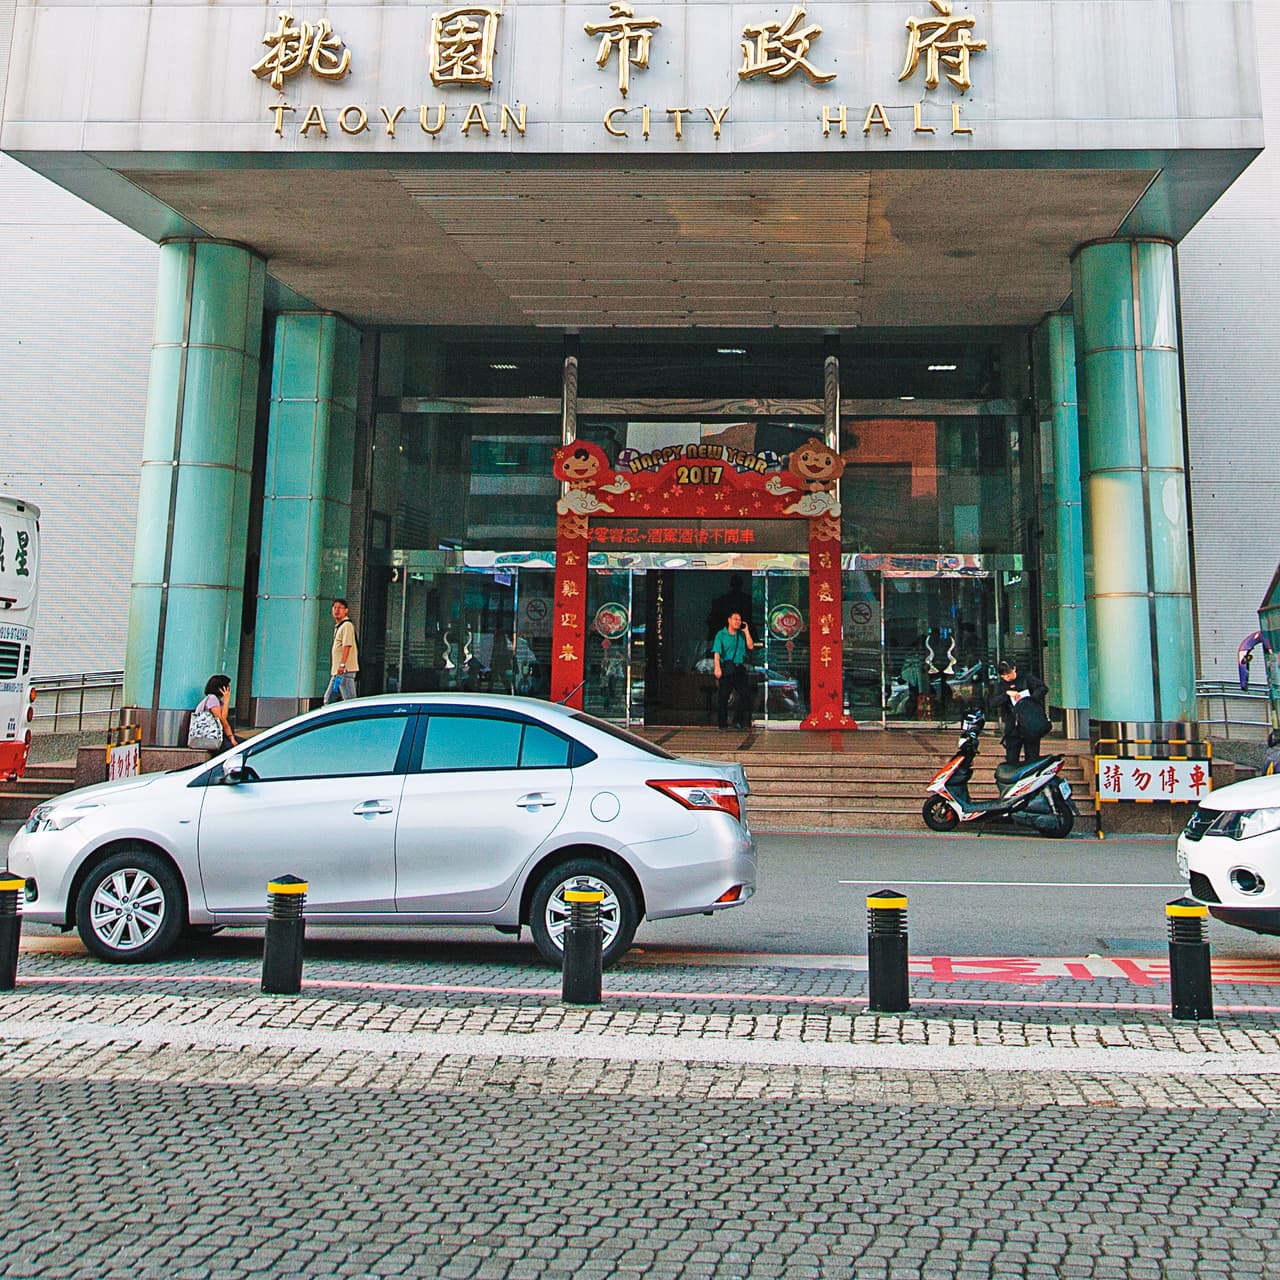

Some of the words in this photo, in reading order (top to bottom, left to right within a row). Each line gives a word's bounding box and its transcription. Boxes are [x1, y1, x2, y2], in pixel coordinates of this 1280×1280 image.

[268, 101, 529, 139] TAOYUAN
[602, 104, 731, 141] CITY
[822, 102, 974, 138] HALL
[628, 445, 684, 475] HAPPY
[685, 443, 724, 460] NEW
[725, 446, 769, 476] YEAR
[676, 465, 724, 485] 2017
[558, 550, 580, 662] 金雞迎春
[1103, 764, 1207, 796] 請勿停車
